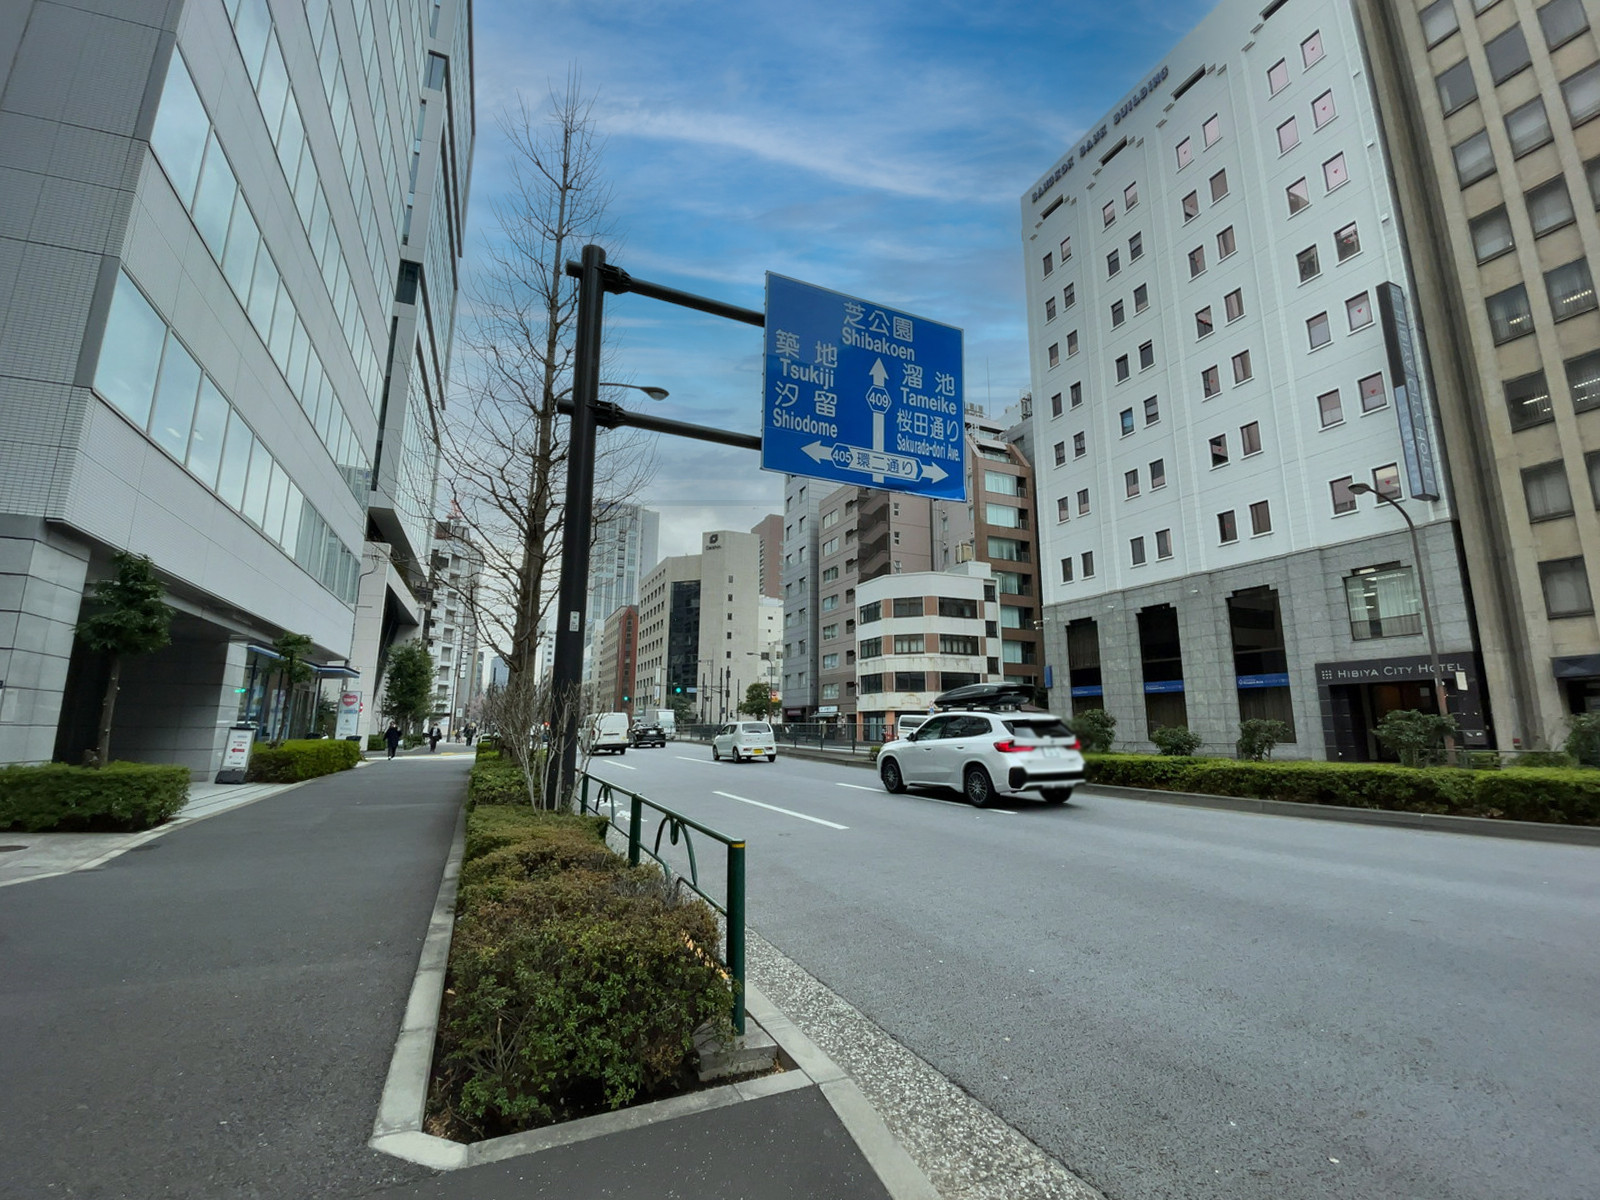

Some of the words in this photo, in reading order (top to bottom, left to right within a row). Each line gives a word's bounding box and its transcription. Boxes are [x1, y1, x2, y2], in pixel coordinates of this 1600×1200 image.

[1080, 124, 1108, 157] BANK
[1113, 65, 1169, 125] BUILDING
[842, 301, 914, 343] 芝公園
[775, 328, 838, 368] 築地
[841, 326, 915, 361] Shibakoen
[779, 358, 834, 390] Tsukiji
[902, 362, 955, 396] 溜池
[774, 380, 838, 418] 汐留
[868, 392, 888, 408] 409
[900, 387, 957, 415] Tameike
[773, 407, 838, 438] Shiodome
[896, 408, 959, 443] 桜田通り
[832, 448, 853, 463] 405
[856, 451, 915, 476] 環二通り
[896, 433, 946, 459] Sakurada-dori
[947, 446, 960, 462] Ave.
[1337, 668, 1379, 679] HIBIYA
[1383, 666, 1413, 676] CITY
